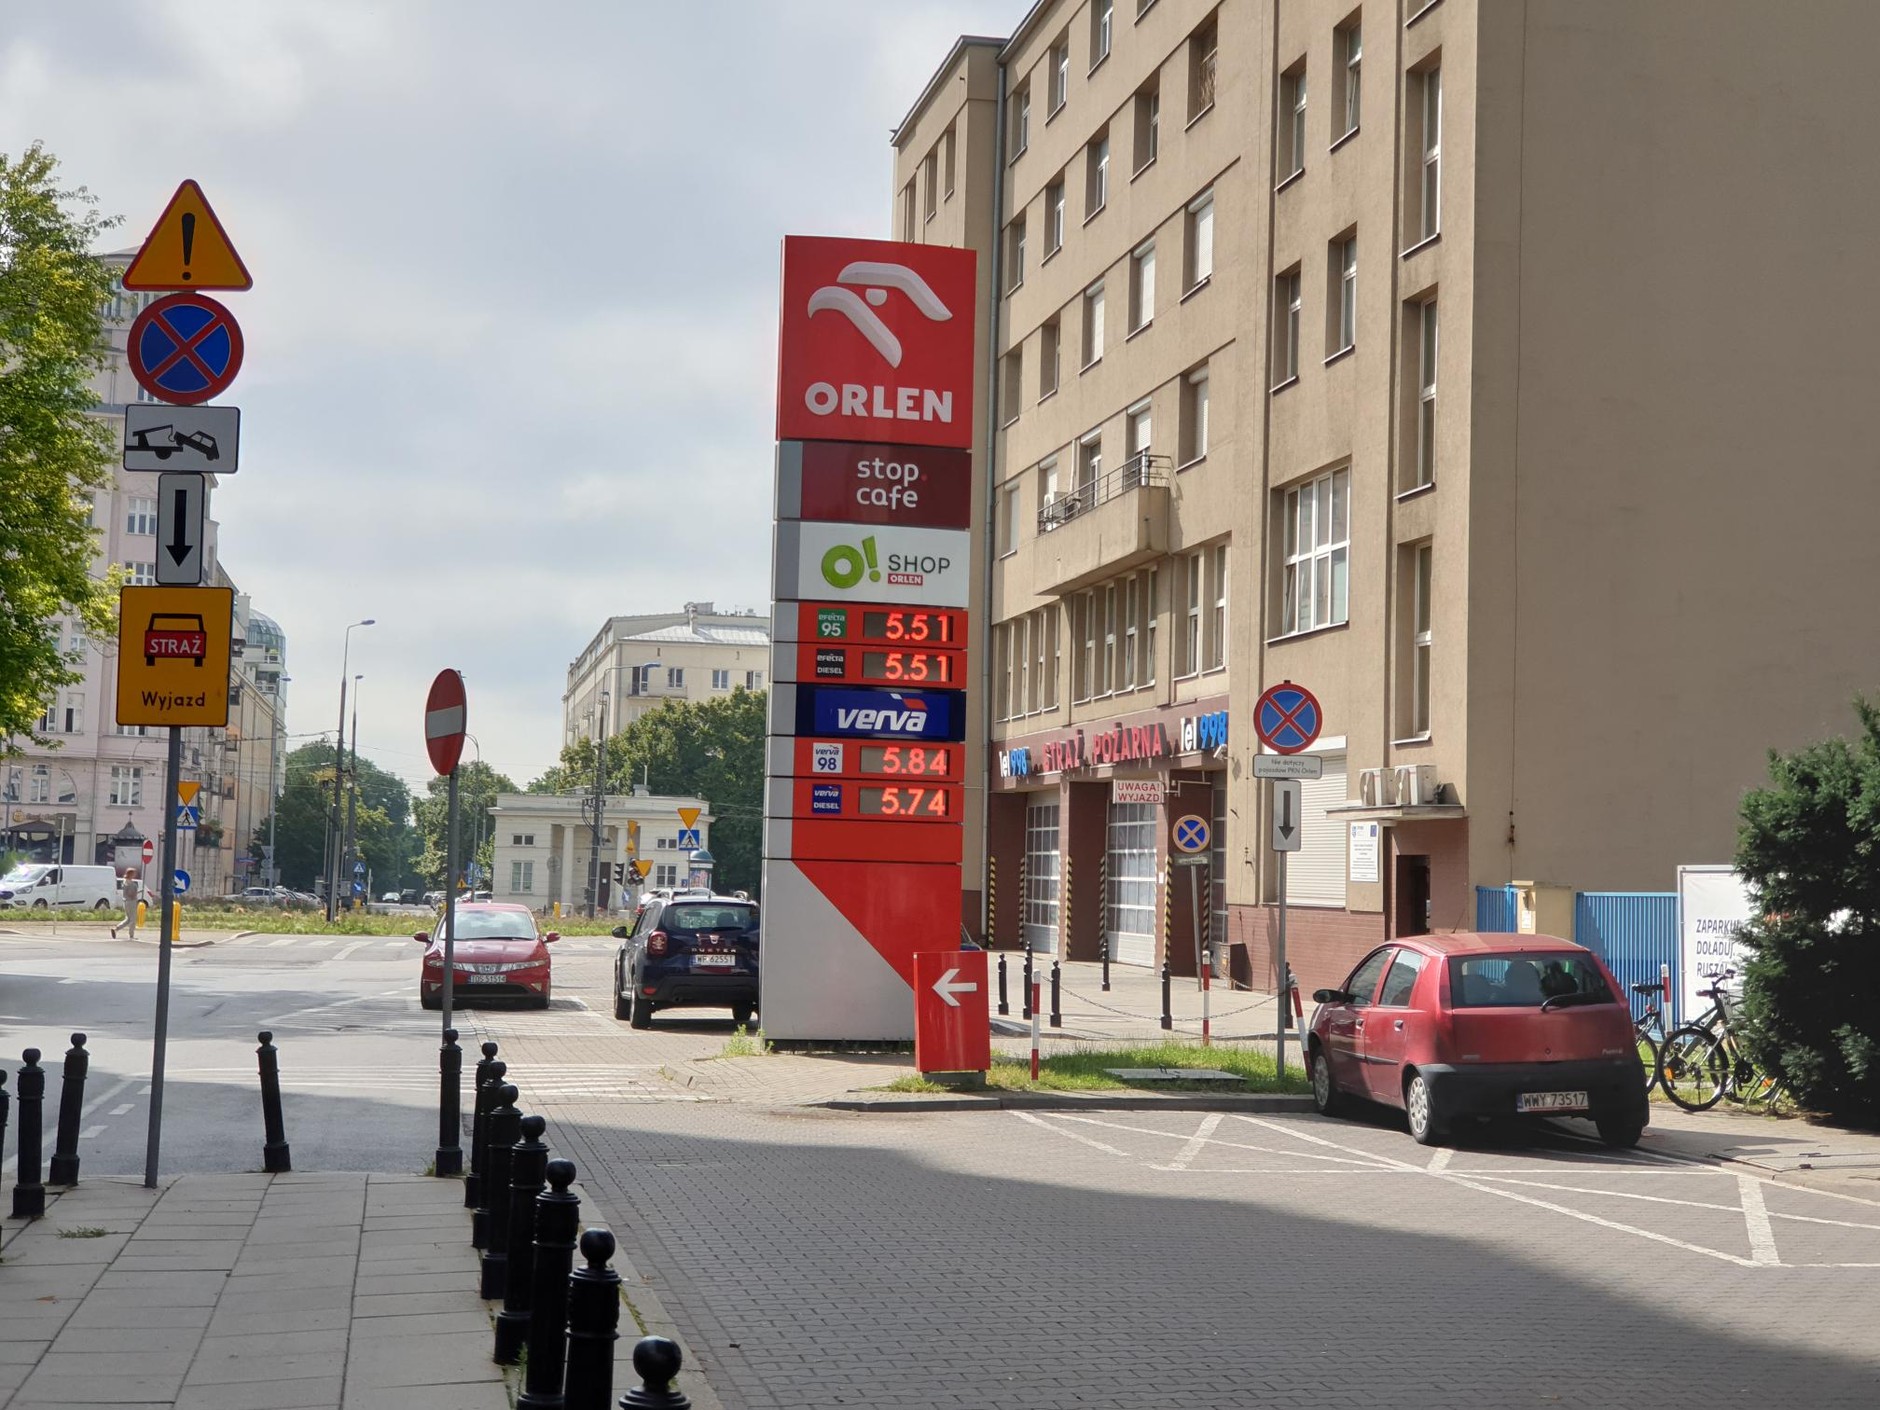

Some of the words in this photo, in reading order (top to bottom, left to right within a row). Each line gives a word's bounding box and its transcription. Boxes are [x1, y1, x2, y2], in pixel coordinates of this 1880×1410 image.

[804, 381, 953, 424] ORLEN
[857, 457, 920, 487] stop
[856, 486, 919, 510] cafe
[888, 554, 951, 575] SHOP
[889, 574, 922, 585] ORLEN
[821, 622, 841, 637] 95
[886, 612, 948, 642] 5.51
[149, 635, 201, 654] STRAŻ
[817, 666, 843, 675] DIESEL
[885, 652, 947, 682] 5.51
[141, 690, 206, 711] Wyjazd
[837, 708, 927, 732] verva
[1200, 709, 1228, 750] 998
[815, 748, 840, 756] verva
[1042, 729, 1083, 772] STRAŻ
[1092, 722, 1164, 765] POŻARNA
[817, 757, 837, 771] 98
[883, 746, 947, 776] 5.84
[1011, 747, 1029, 777] 998
[814, 789, 839, 798] verva
[1117, 782, 1160, 793] UWAGA!
[1118, 793, 1160, 803] WYJAZD
[813, 802, 840, 810] DIESEL
[881, 787, 946, 816] 5.74
[1523, 1093, 1546, 1107] WWY
[1550, 1092, 1586, 1106] 73517
